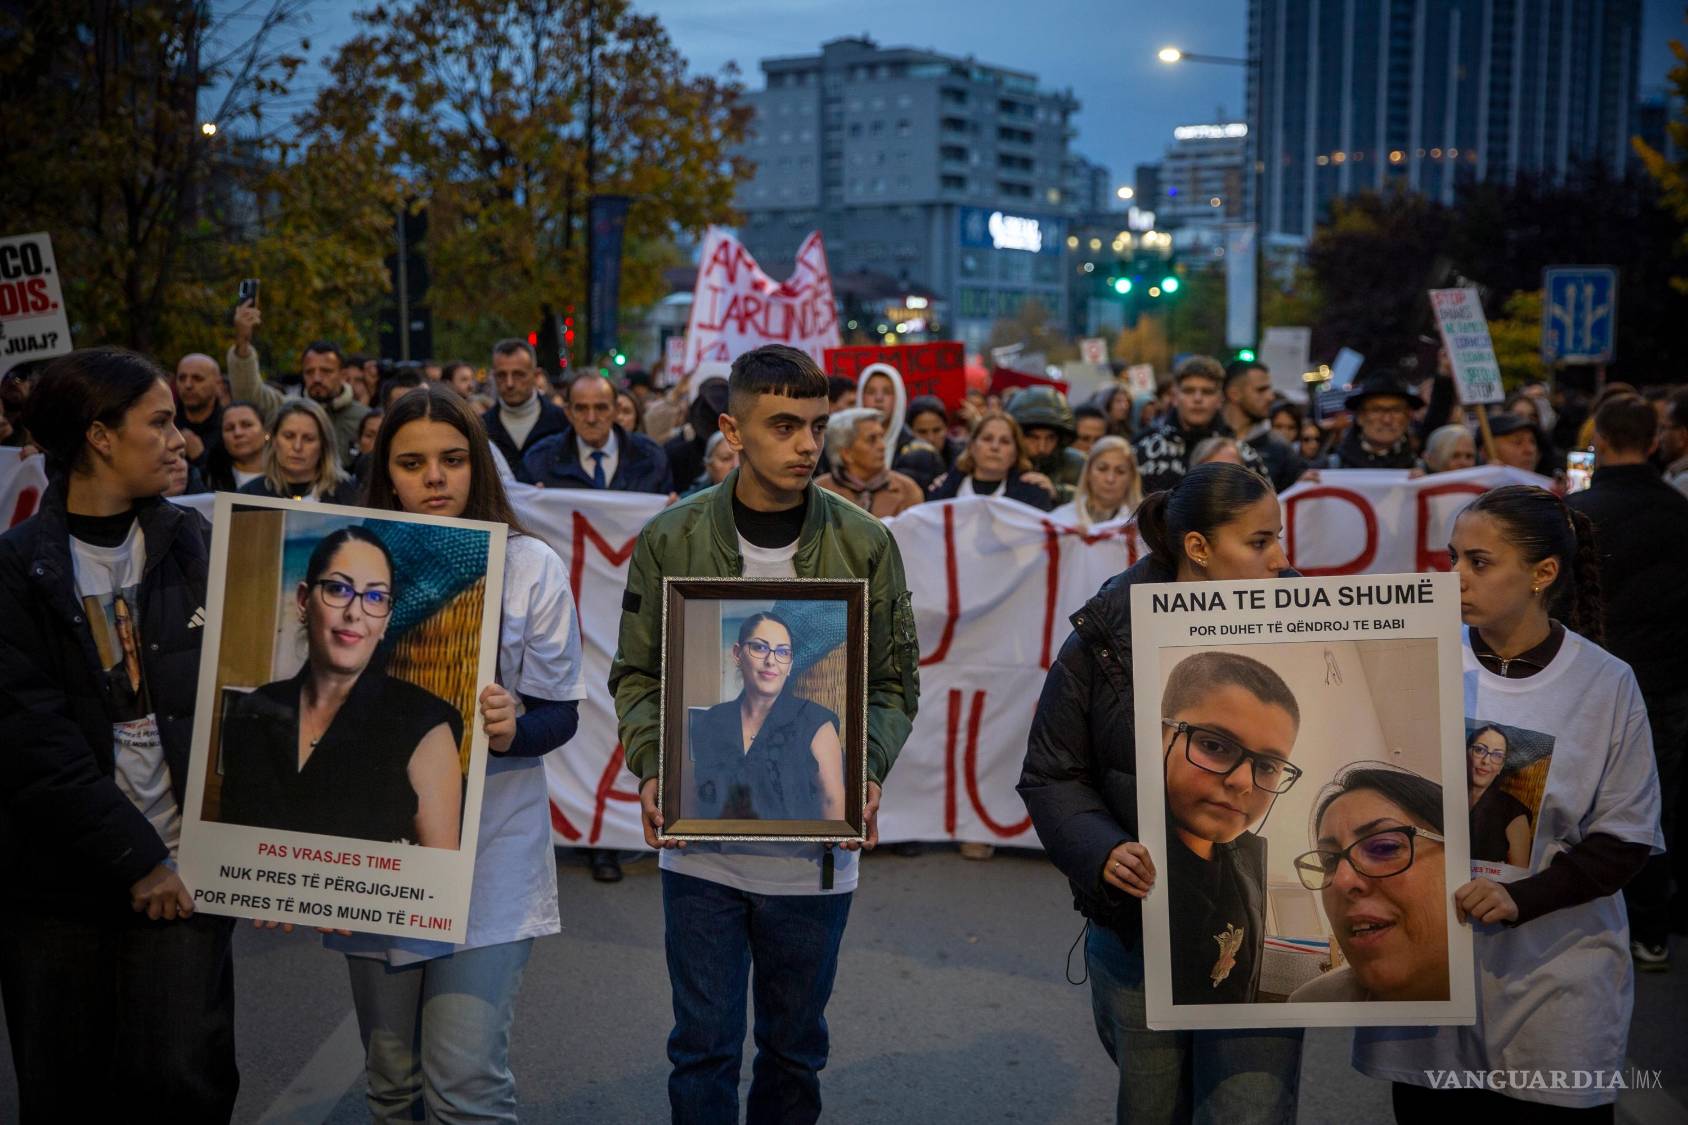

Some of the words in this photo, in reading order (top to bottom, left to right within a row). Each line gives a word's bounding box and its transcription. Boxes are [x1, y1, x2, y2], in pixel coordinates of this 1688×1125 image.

[5, 332, 58, 355] JUAJ?
[1152, 591, 1227, 613] NANA
[1232, 589, 1266, 610] TE
[1275, 587, 1331, 609] DUA
[1338, 578, 1434, 606] SHUMË
[1189, 625, 1217, 636] POR
[1220, 623, 1263, 635] DUHET
[1267, 620, 1283, 633] TË
[1286, 619, 1349, 633] QËNDROJ
[1353, 619, 1370, 630] TE
[1373, 618, 1405, 630] BABI
[258, 842, 288, 858] PAS
[292, 846, 361, 867] VRASJES
[366, 855, 402, 871] TIME
[219, 865, 252, 881] NUK
[256, 869, 297, 886] PRES
[301, 873, 321, 889] TË
[324, 876, 425, 901] PËRGJIGJENI
[193, 889, 226, 905] POR
[230, 893, 272, 910] PRES
[276, 897, 296, 913] TË
[299, 901, 333, 917] MOS
[337, 906, 382, 923] MUND
[387, 910, 406, 926] TË
[409, 914, 453, 931] FLINI!
